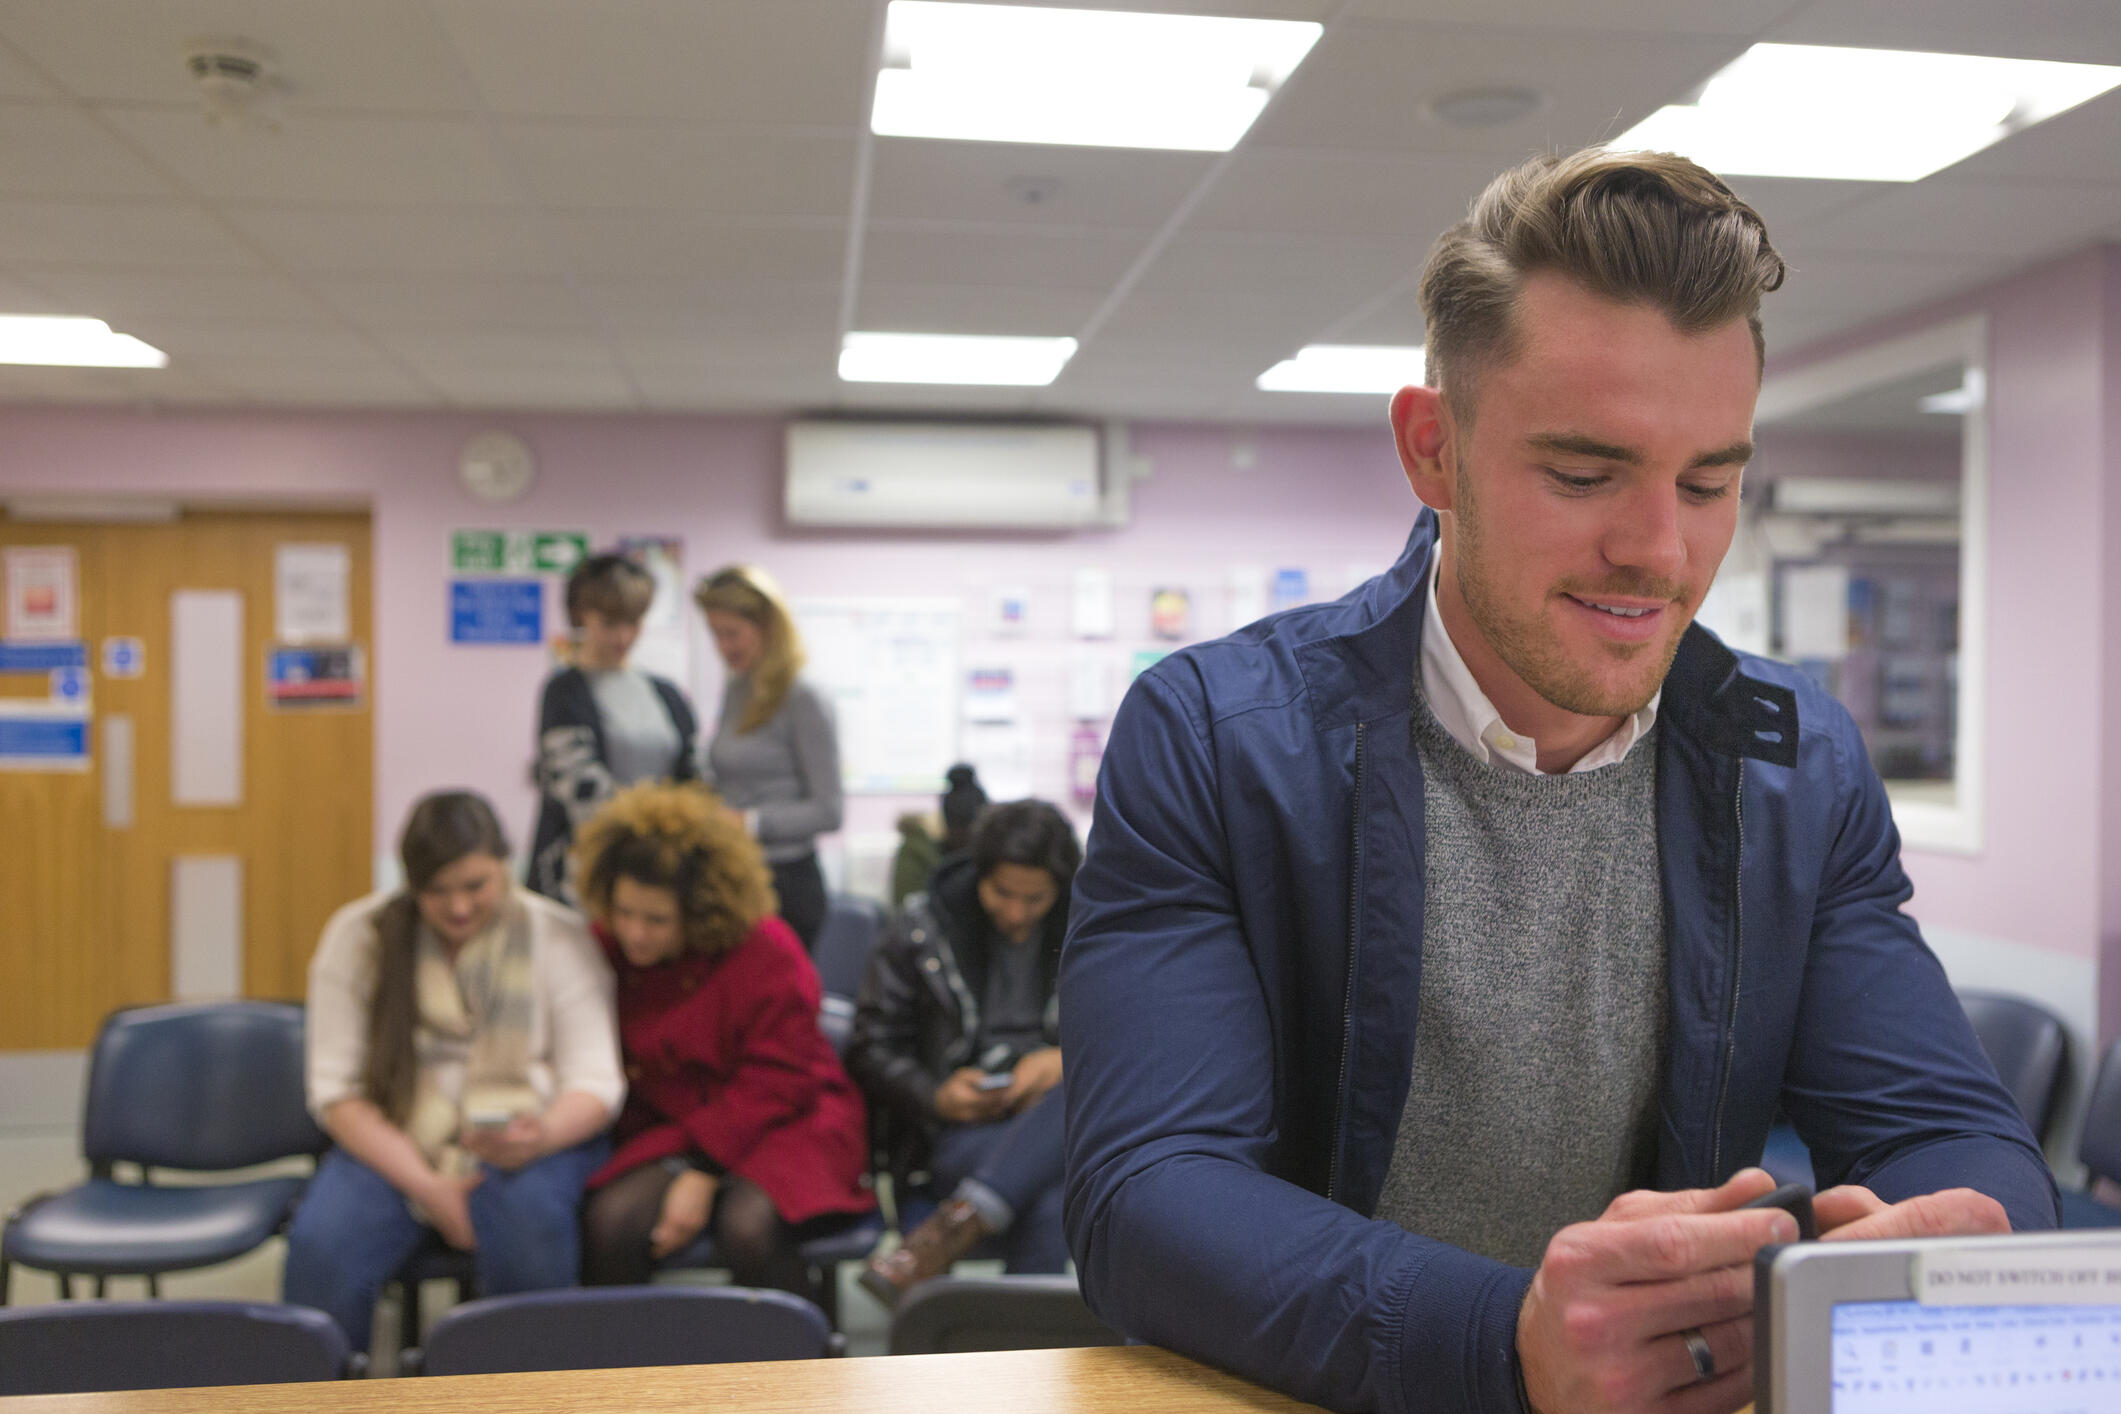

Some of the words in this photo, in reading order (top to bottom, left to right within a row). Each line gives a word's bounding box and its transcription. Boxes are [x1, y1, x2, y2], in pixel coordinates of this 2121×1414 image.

[1928, 1270, 1954, 1286] DO
[1958, 1270, 1991, 1286] NOT
[1998, 1269, 2063, 1285] SWITCH
[2067, 1269, 2098, 1284] OFF
